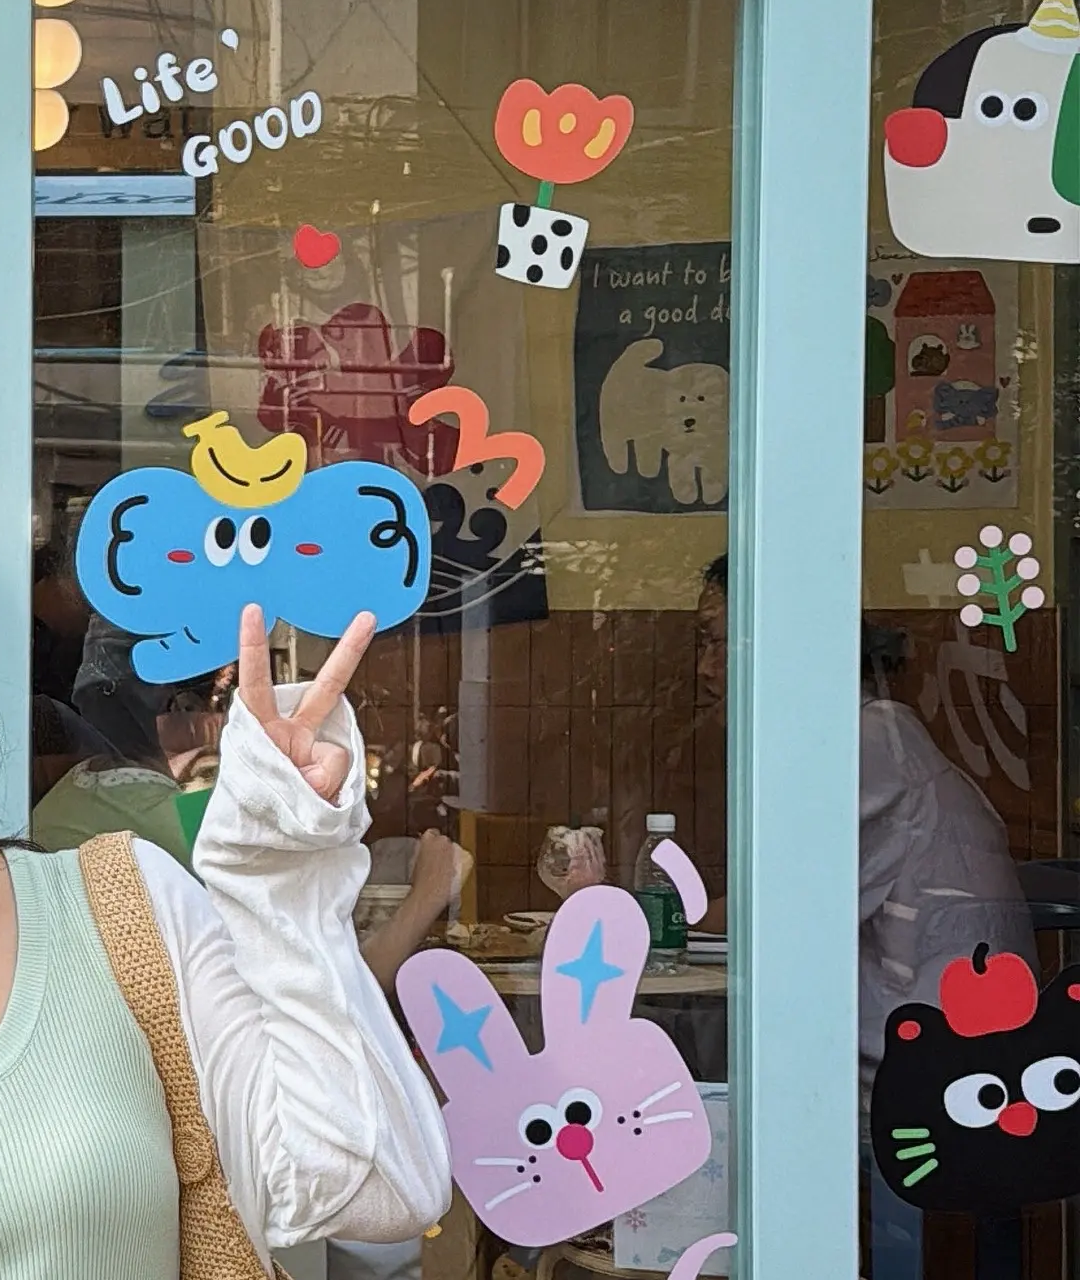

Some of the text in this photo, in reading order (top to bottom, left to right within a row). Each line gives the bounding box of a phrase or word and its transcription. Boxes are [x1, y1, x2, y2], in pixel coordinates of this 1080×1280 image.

[182, 91, 322, 177] GOOD
[593, 263, 600, 288] I
[610, 261, 673, 289] want
[683, 260, 708, 286] to
[619, 308, 633, 325] a
[643, 294, 699, 338] good
